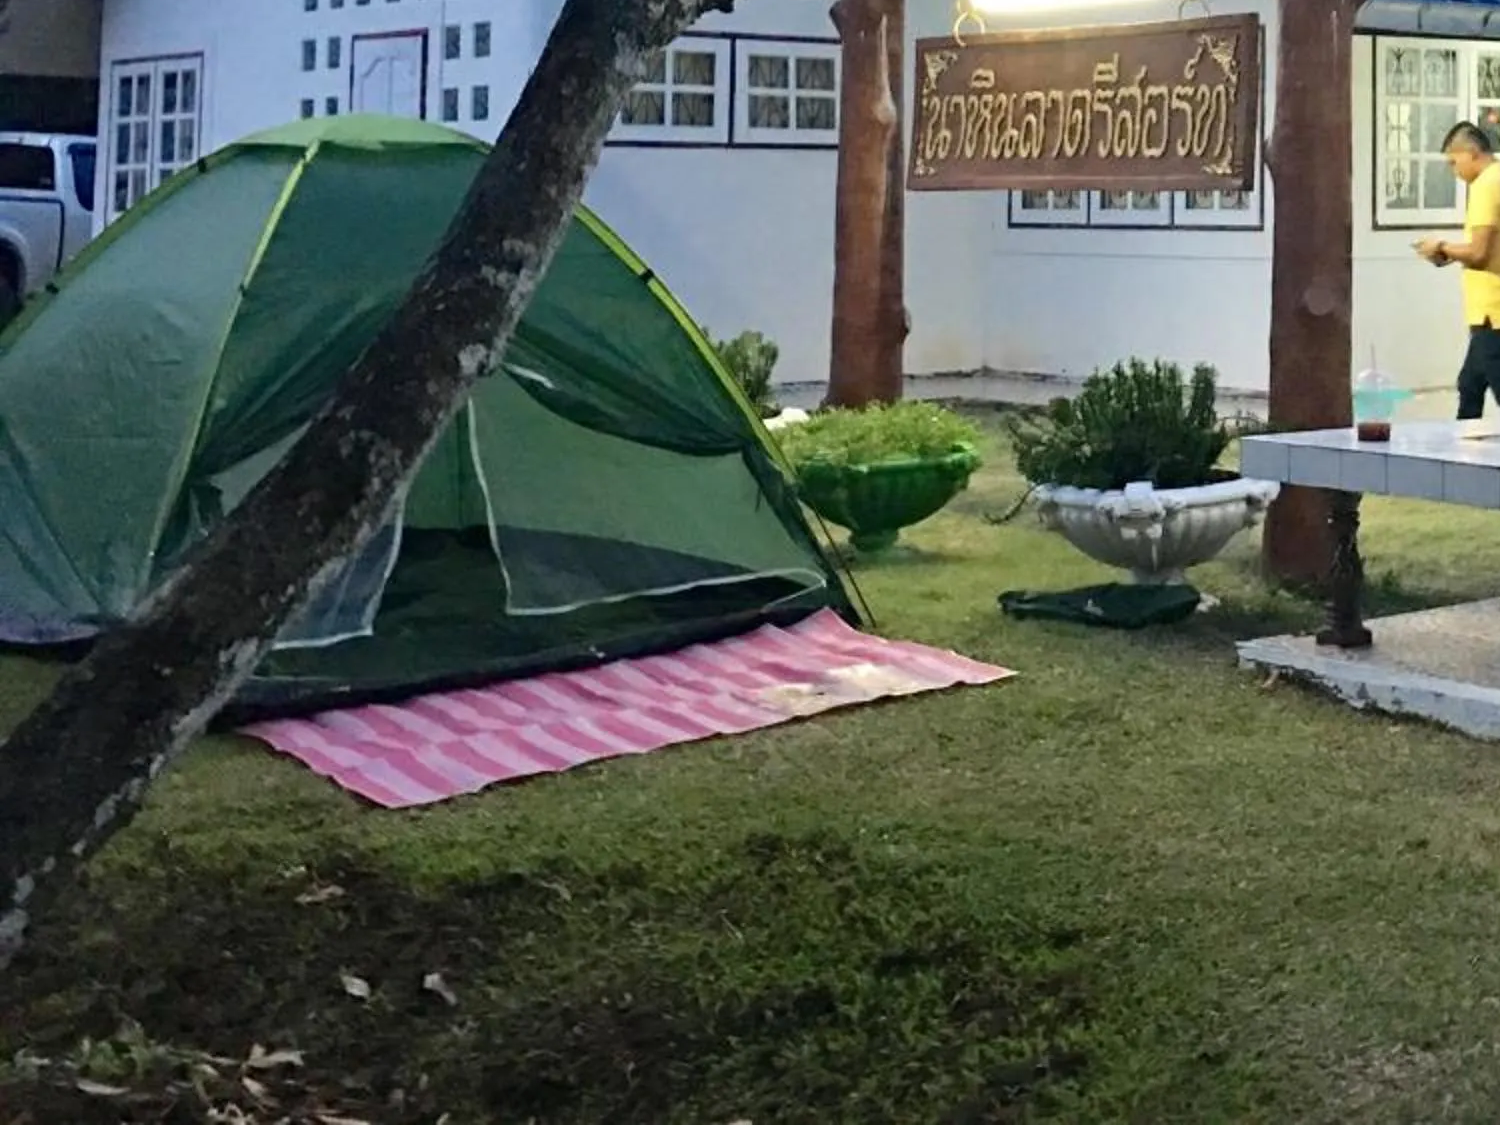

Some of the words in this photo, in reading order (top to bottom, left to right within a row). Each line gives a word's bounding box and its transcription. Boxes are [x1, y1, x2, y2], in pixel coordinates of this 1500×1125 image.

[923, 47, 1229, 160] นาหินลาดรีสอร์ท
